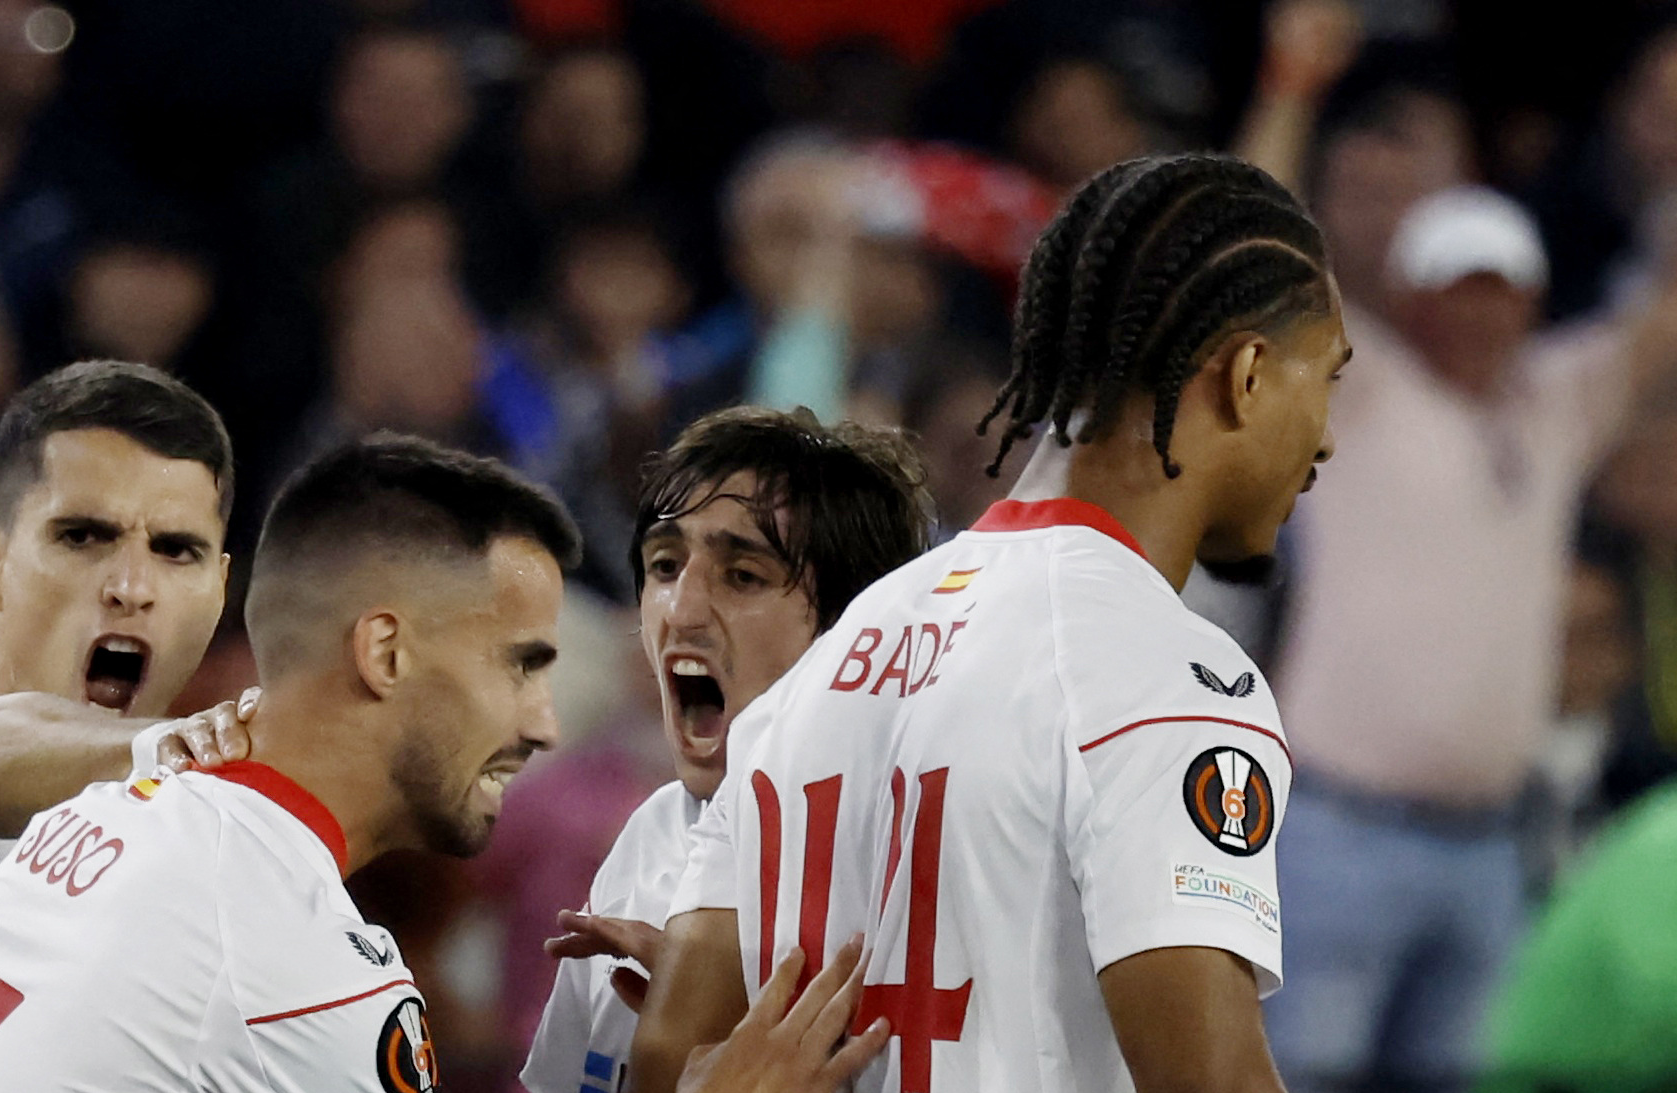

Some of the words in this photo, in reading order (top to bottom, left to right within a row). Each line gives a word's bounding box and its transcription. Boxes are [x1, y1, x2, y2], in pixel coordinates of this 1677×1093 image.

[828, 601, 977, 698] BADÉ
[1223, 788, 1246, 819] 6
[15, 807, 124, 897] SUSO
[1174, 864, 1205, 875] UEFA
[1175, 875, 1278, 923] FOUNDATION
